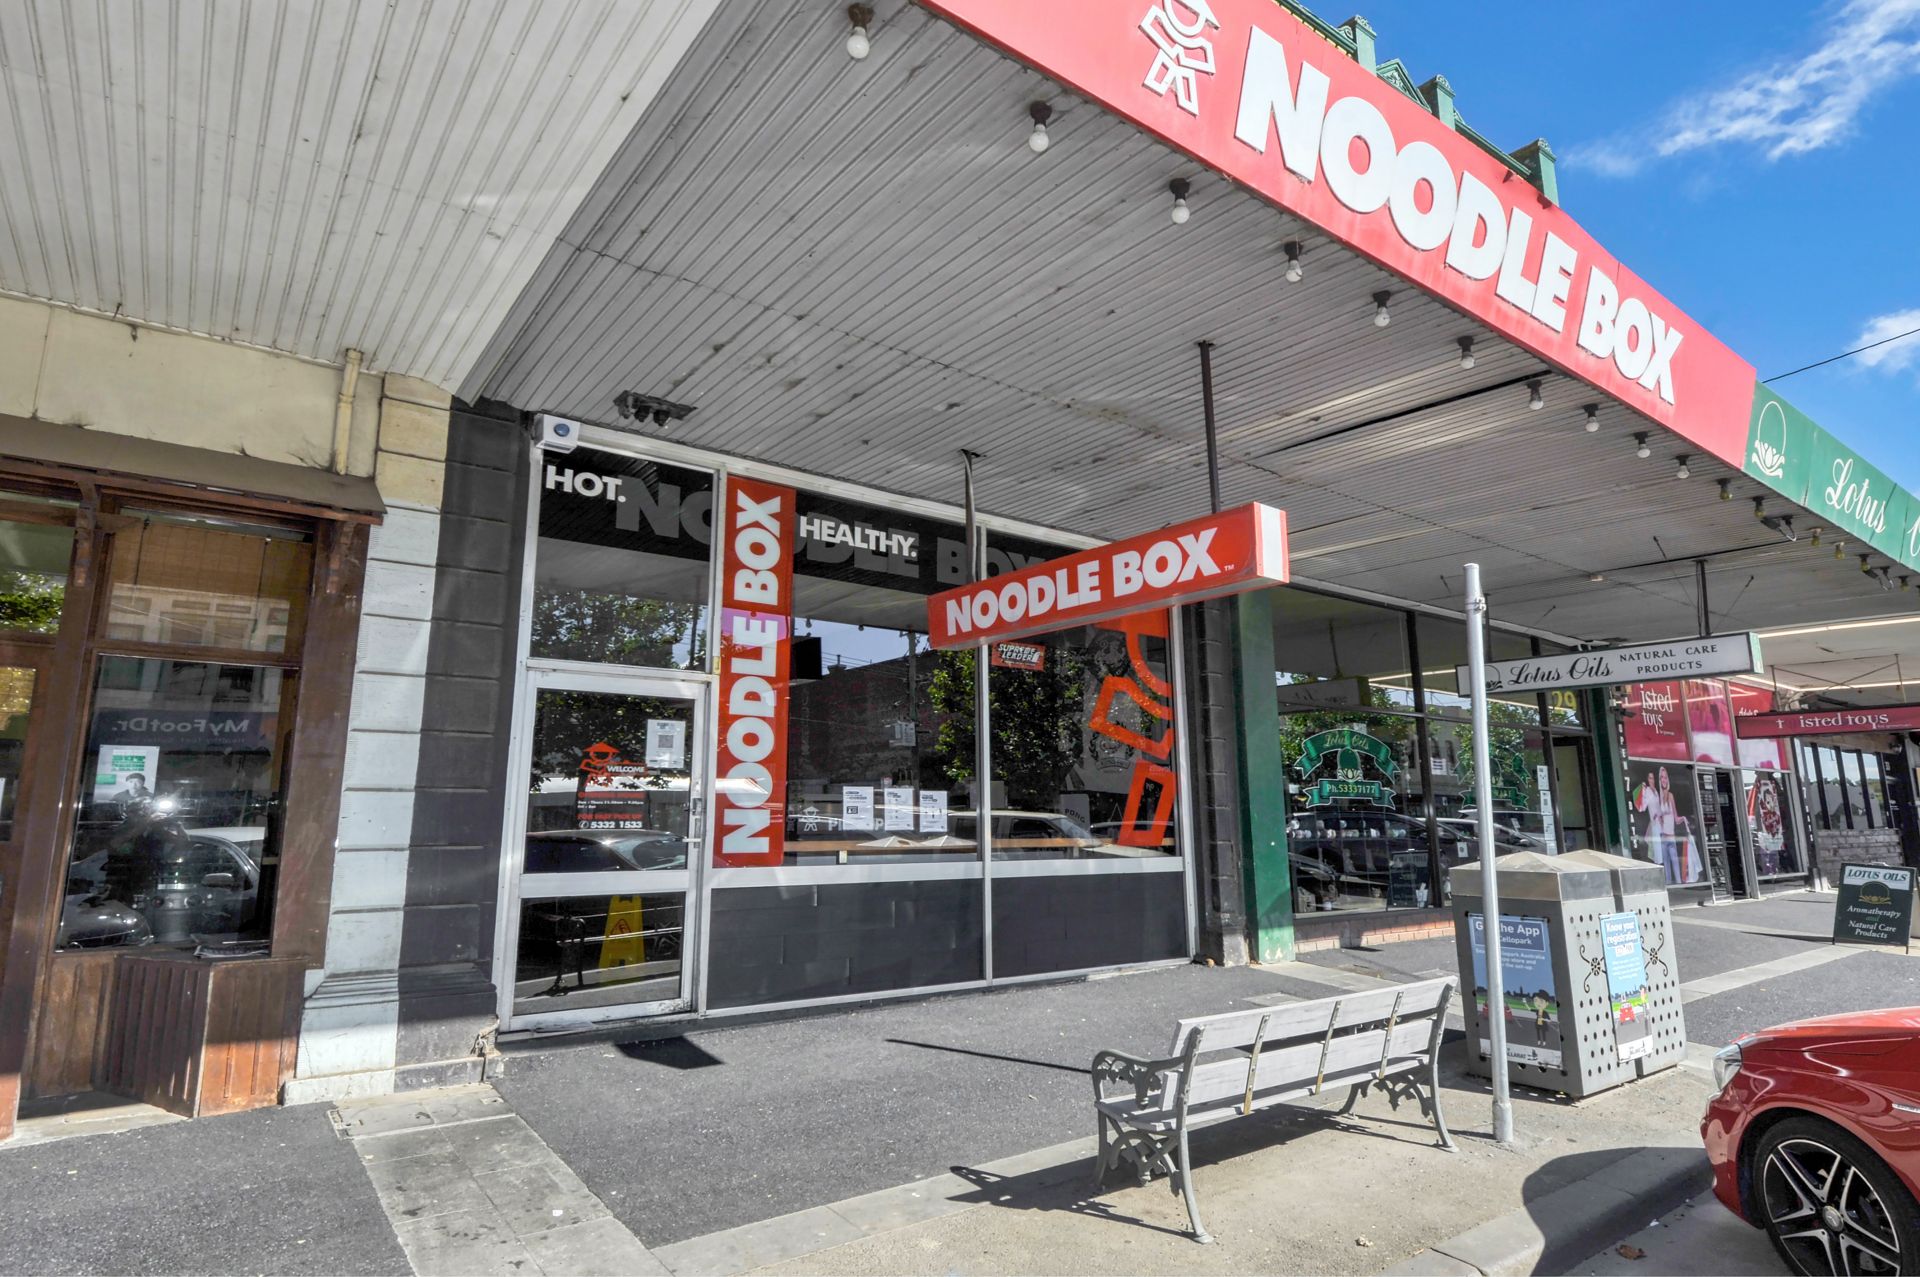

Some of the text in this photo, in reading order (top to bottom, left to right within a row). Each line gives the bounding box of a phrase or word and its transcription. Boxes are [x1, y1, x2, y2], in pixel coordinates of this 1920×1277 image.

[1233, 25, 1684, 405] NOODLE BOX
[545, 465, 627, 503] HOT.
[1825, 458, 1886, 534] Lotus
[800, 515, 917, 558] HEALTHY.
[947, 560, 1101, 636] NOODLE
[1112, 527, 1222, 597] BOX
[722, 489, 781, 855] NOODLE BOX
[1507, 644, 1718, 685] Lotus Oils NATURAL CARE
[1637, 660, 1703, 675] PRODUCTS
[1641, 709, 1664, 735] toys
[1845, 713, 1889, 730] toys
[606, 765, 645, 773] WELCOME
[590, 820, 643, 829] 5332 1533
[1847, 869, 1908, 881] LOTUS OILS
[1846, 905, 1901, 919] Aromatherapy
[1500, 922, 1540, 937] he App
[1848, 920, 1897, 932] Natural Care
[1855, 928, 1888, 939] Products
